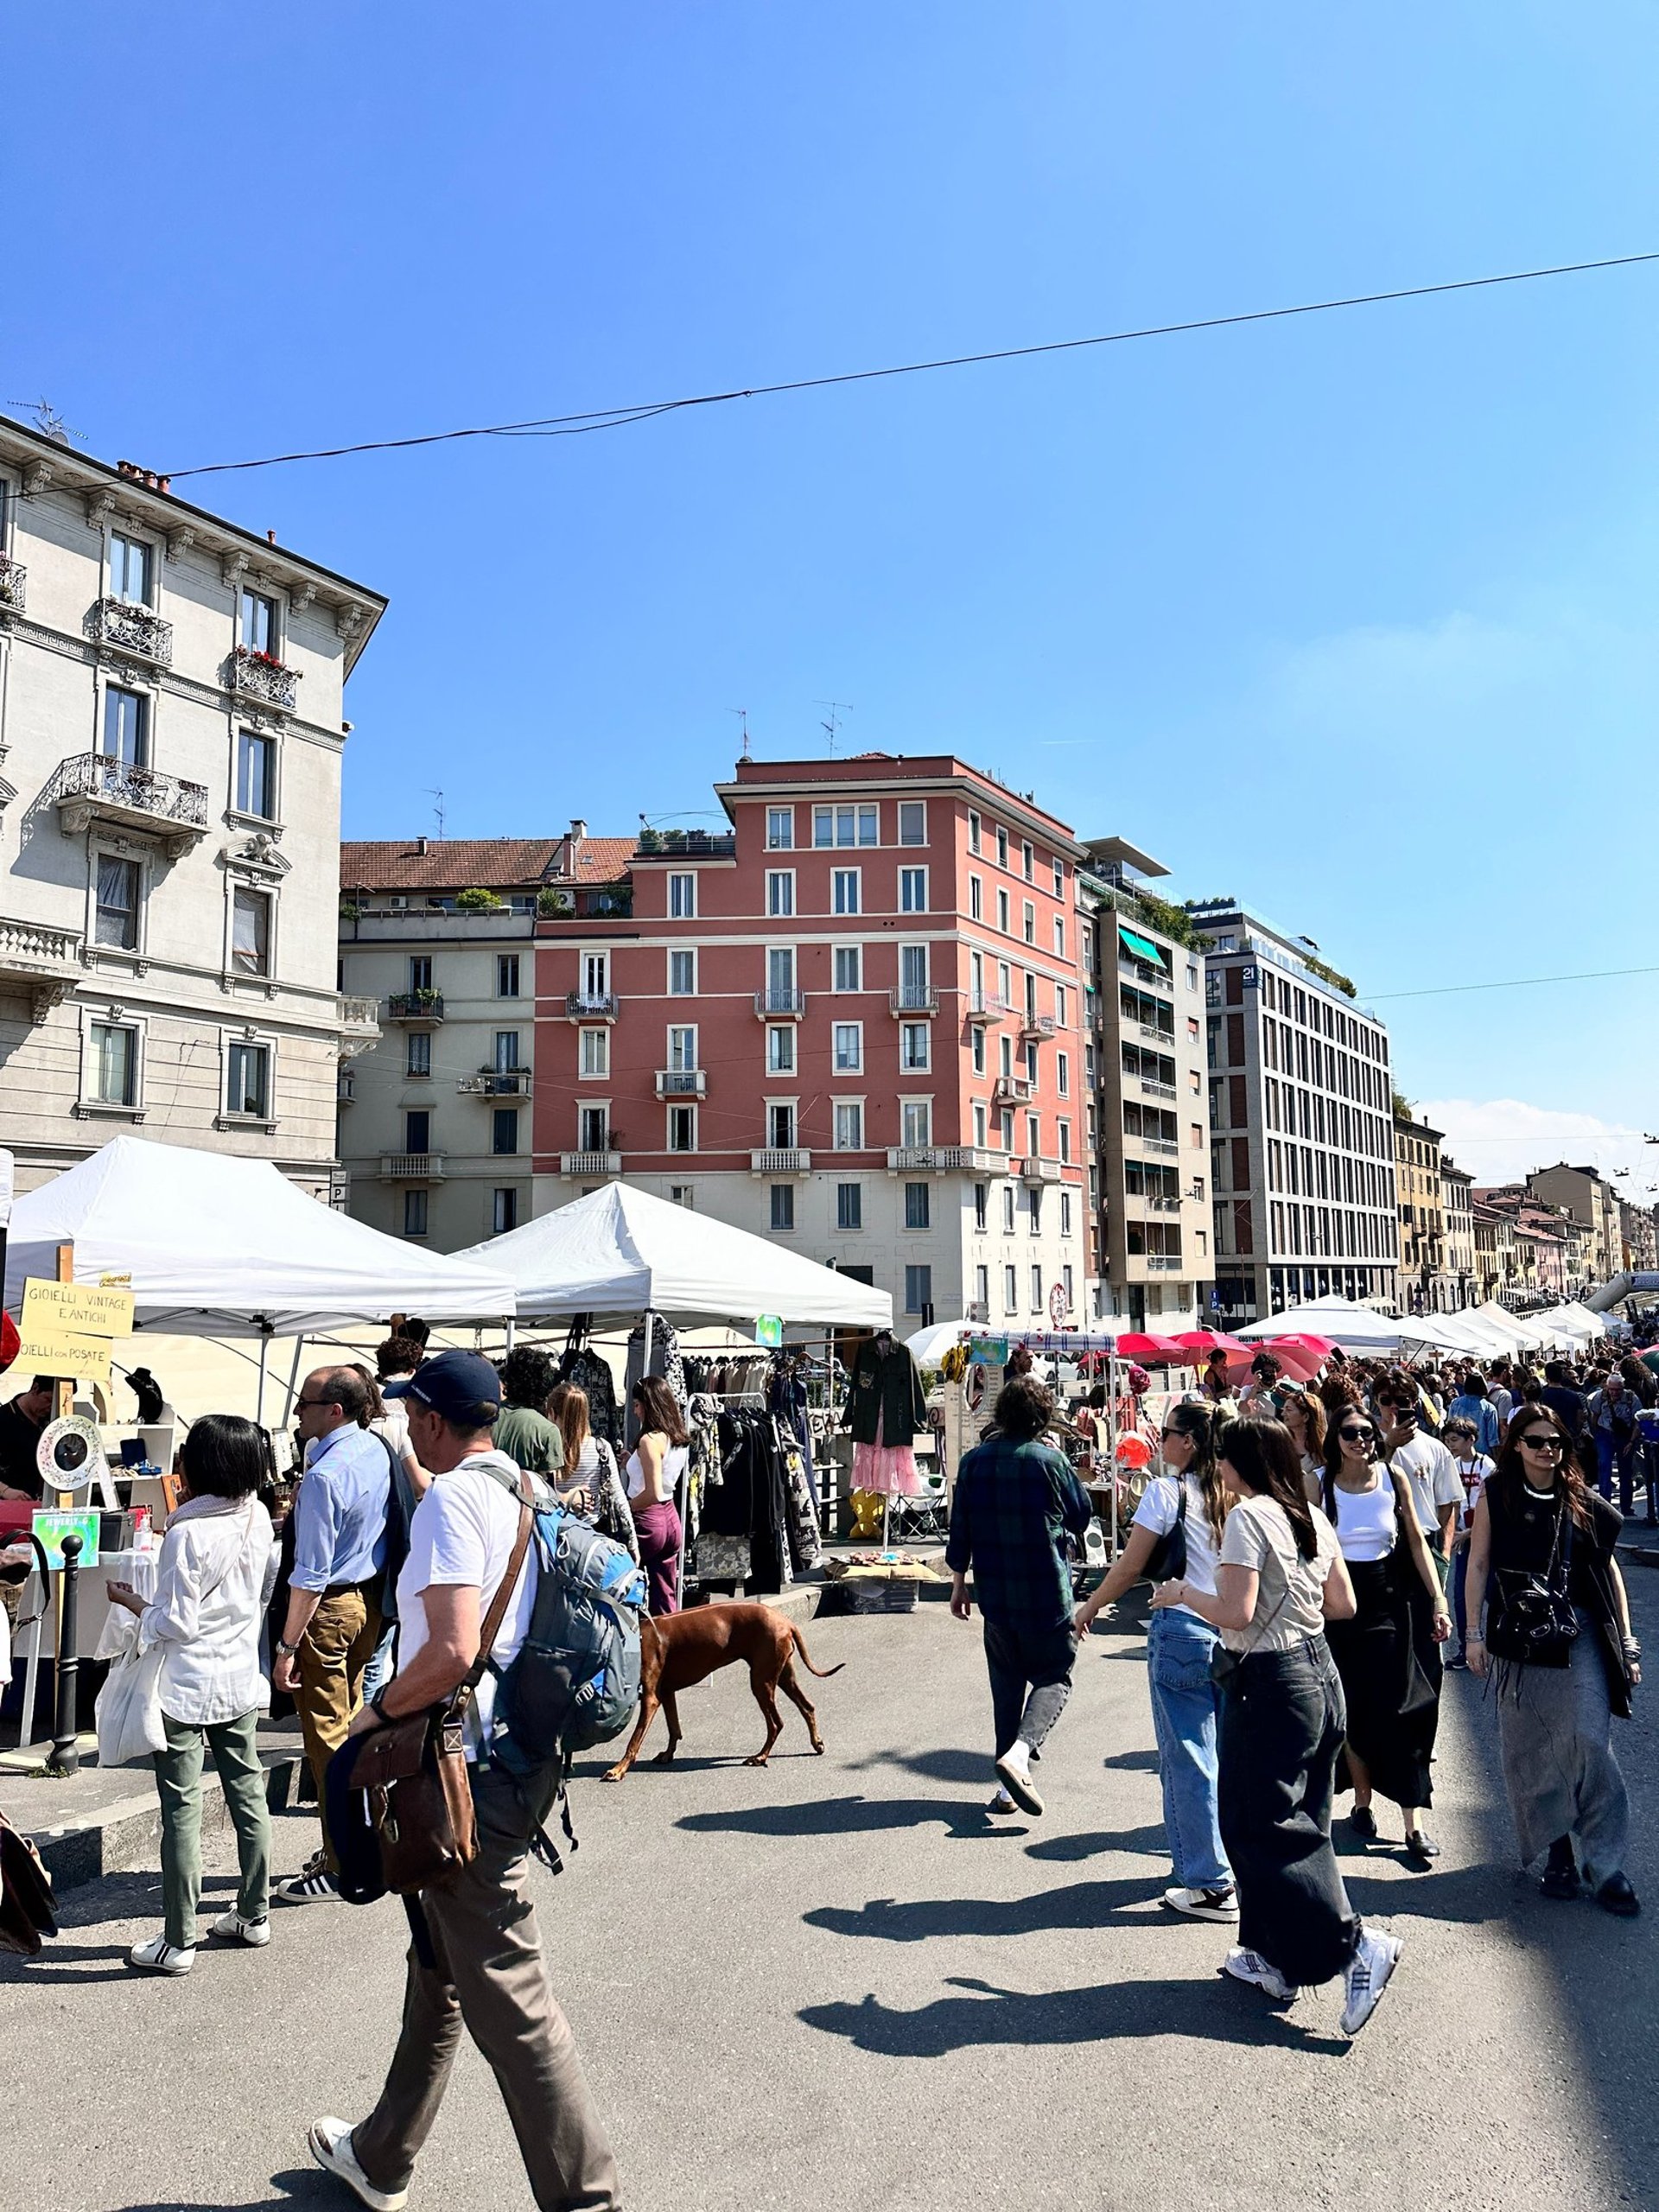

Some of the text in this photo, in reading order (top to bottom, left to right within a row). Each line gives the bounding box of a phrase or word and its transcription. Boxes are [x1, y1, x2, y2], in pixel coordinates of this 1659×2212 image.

[29, 1287, 127, 1310] GIOIELLI VINTAGE
[59, 1308, 106, 1324] E ANTICHI
[21, 1344, 53, 1357] OIELLI
[69, 1348, 105, 1362] POSATE
